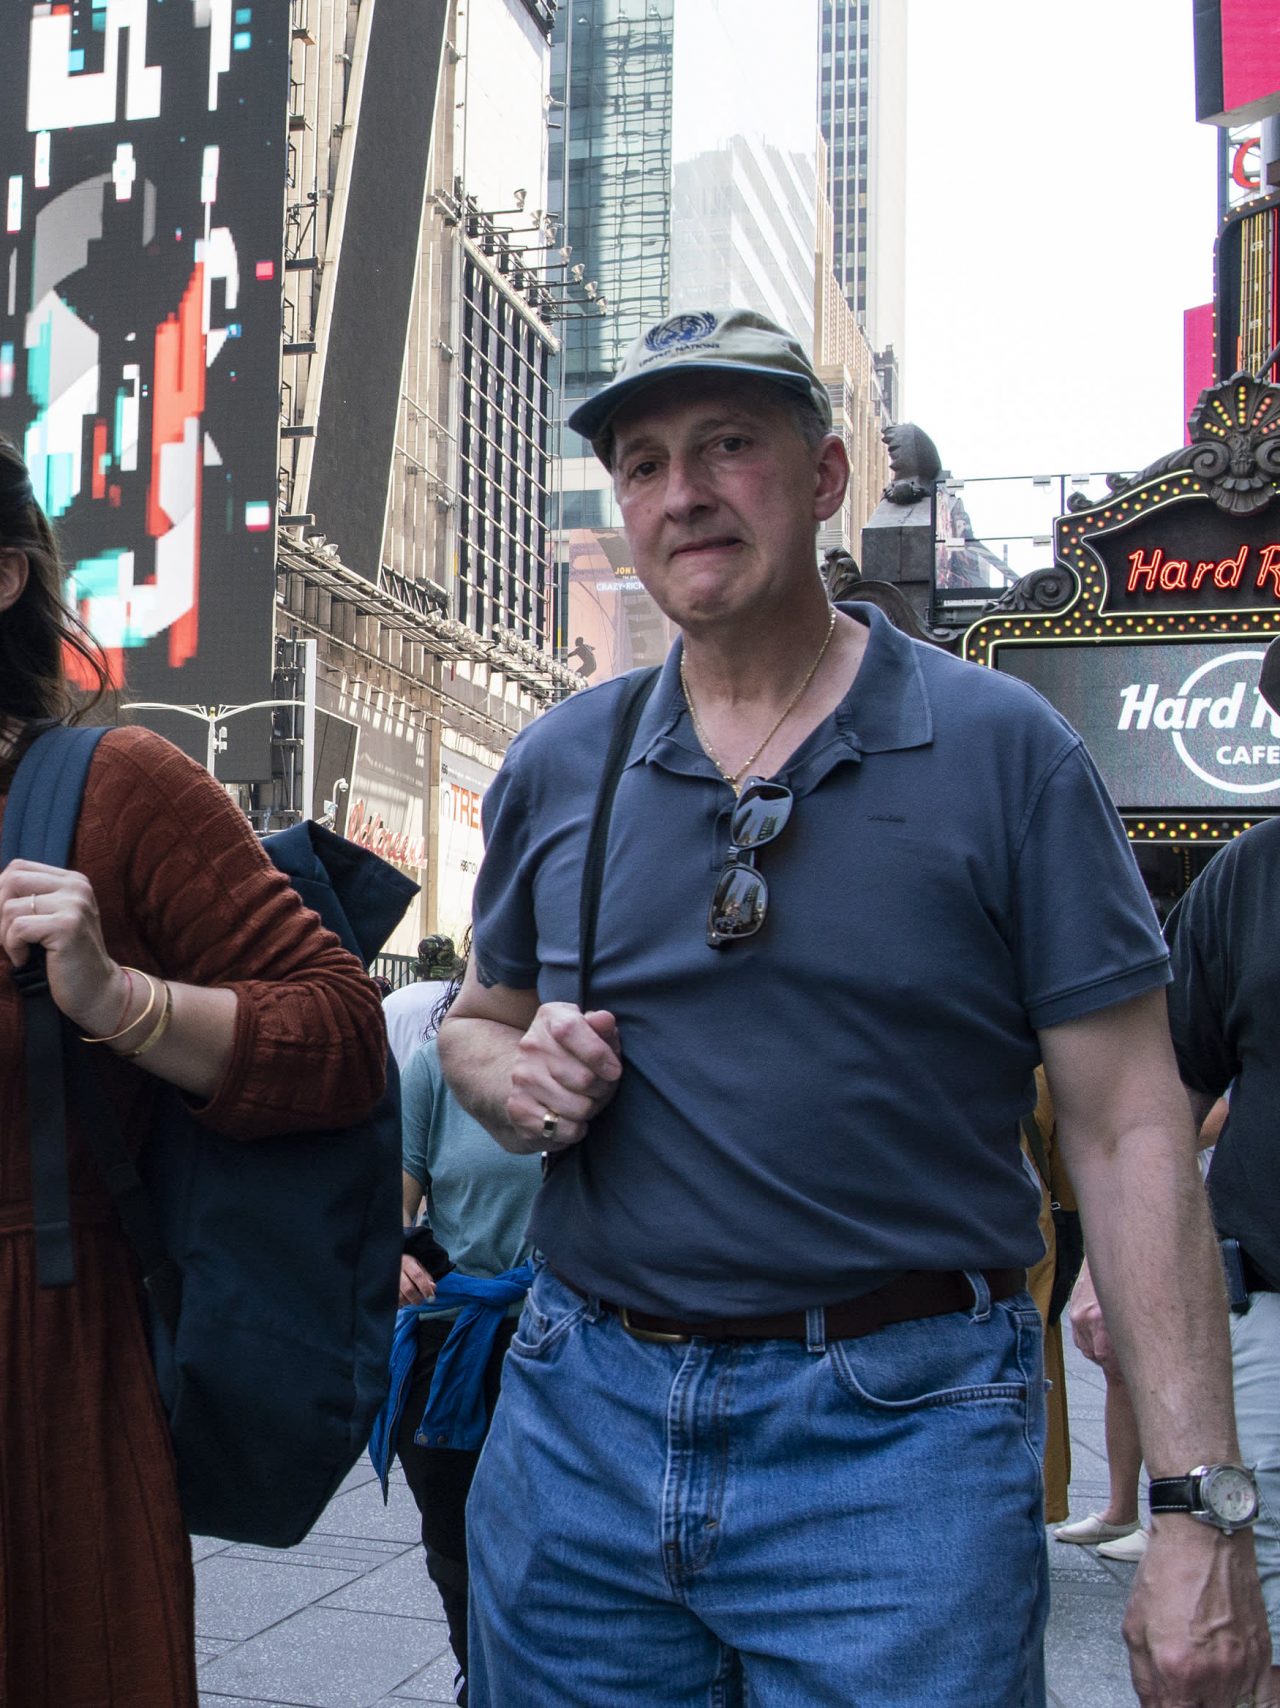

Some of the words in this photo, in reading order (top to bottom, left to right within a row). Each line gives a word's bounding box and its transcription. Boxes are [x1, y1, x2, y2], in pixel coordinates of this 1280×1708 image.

[675, 343, 720, 353] NATIONS
[1127, 545, 1249, 592] Hard
[1117, 681, 1247, 730] Hard
[1216, 746, 1280, 765] CAFE
